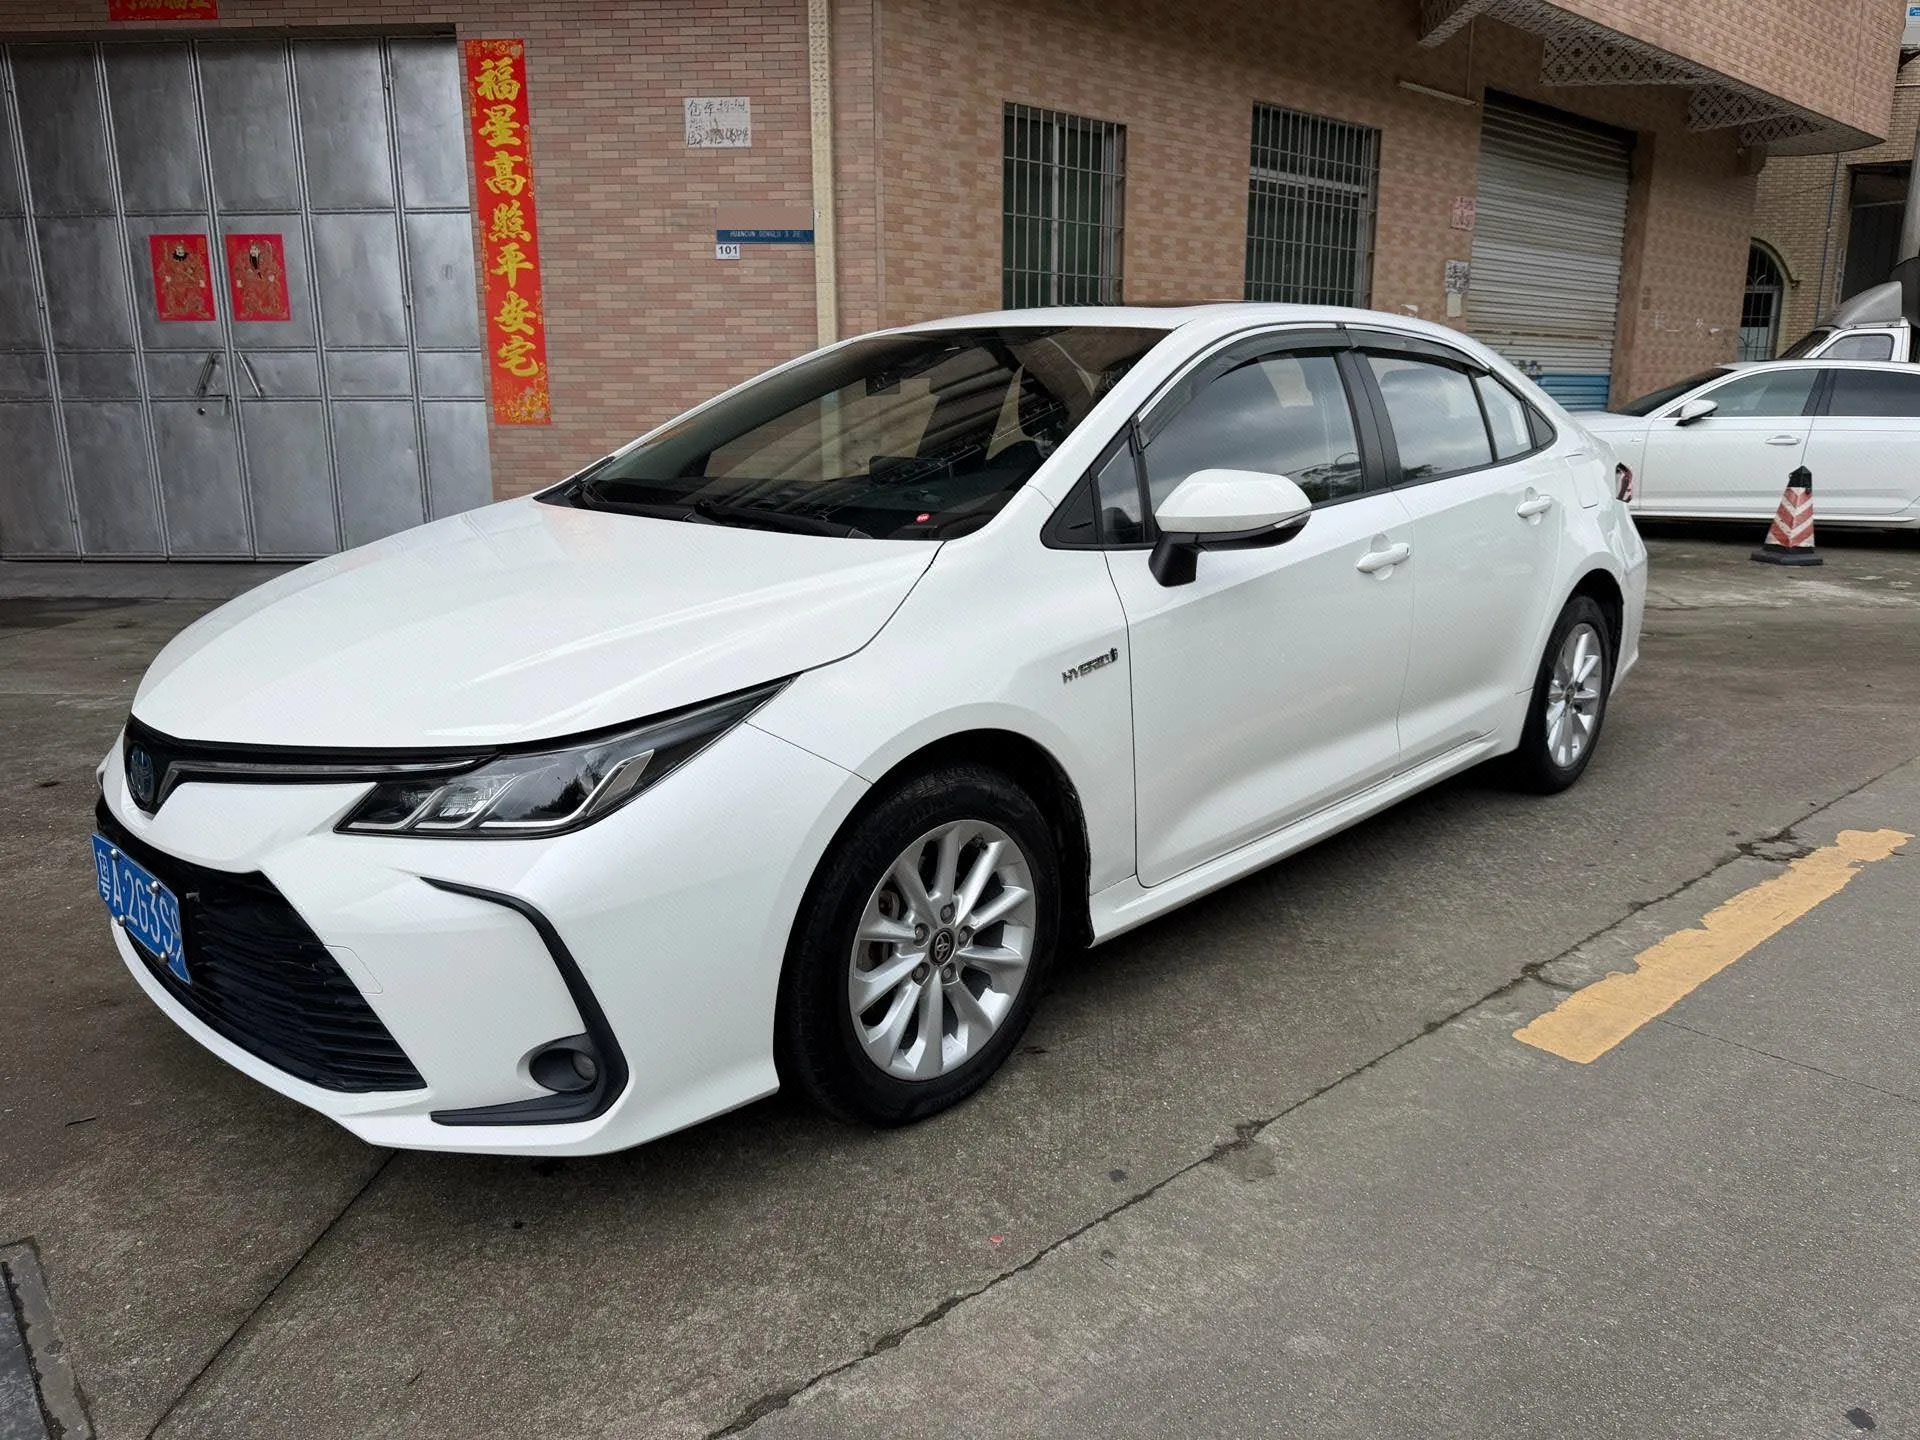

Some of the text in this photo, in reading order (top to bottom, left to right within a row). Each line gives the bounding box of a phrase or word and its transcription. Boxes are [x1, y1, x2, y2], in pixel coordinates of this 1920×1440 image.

[474, 57, 540, 377] 福星高照平安宅
[718, 245, 737, 255] 101
